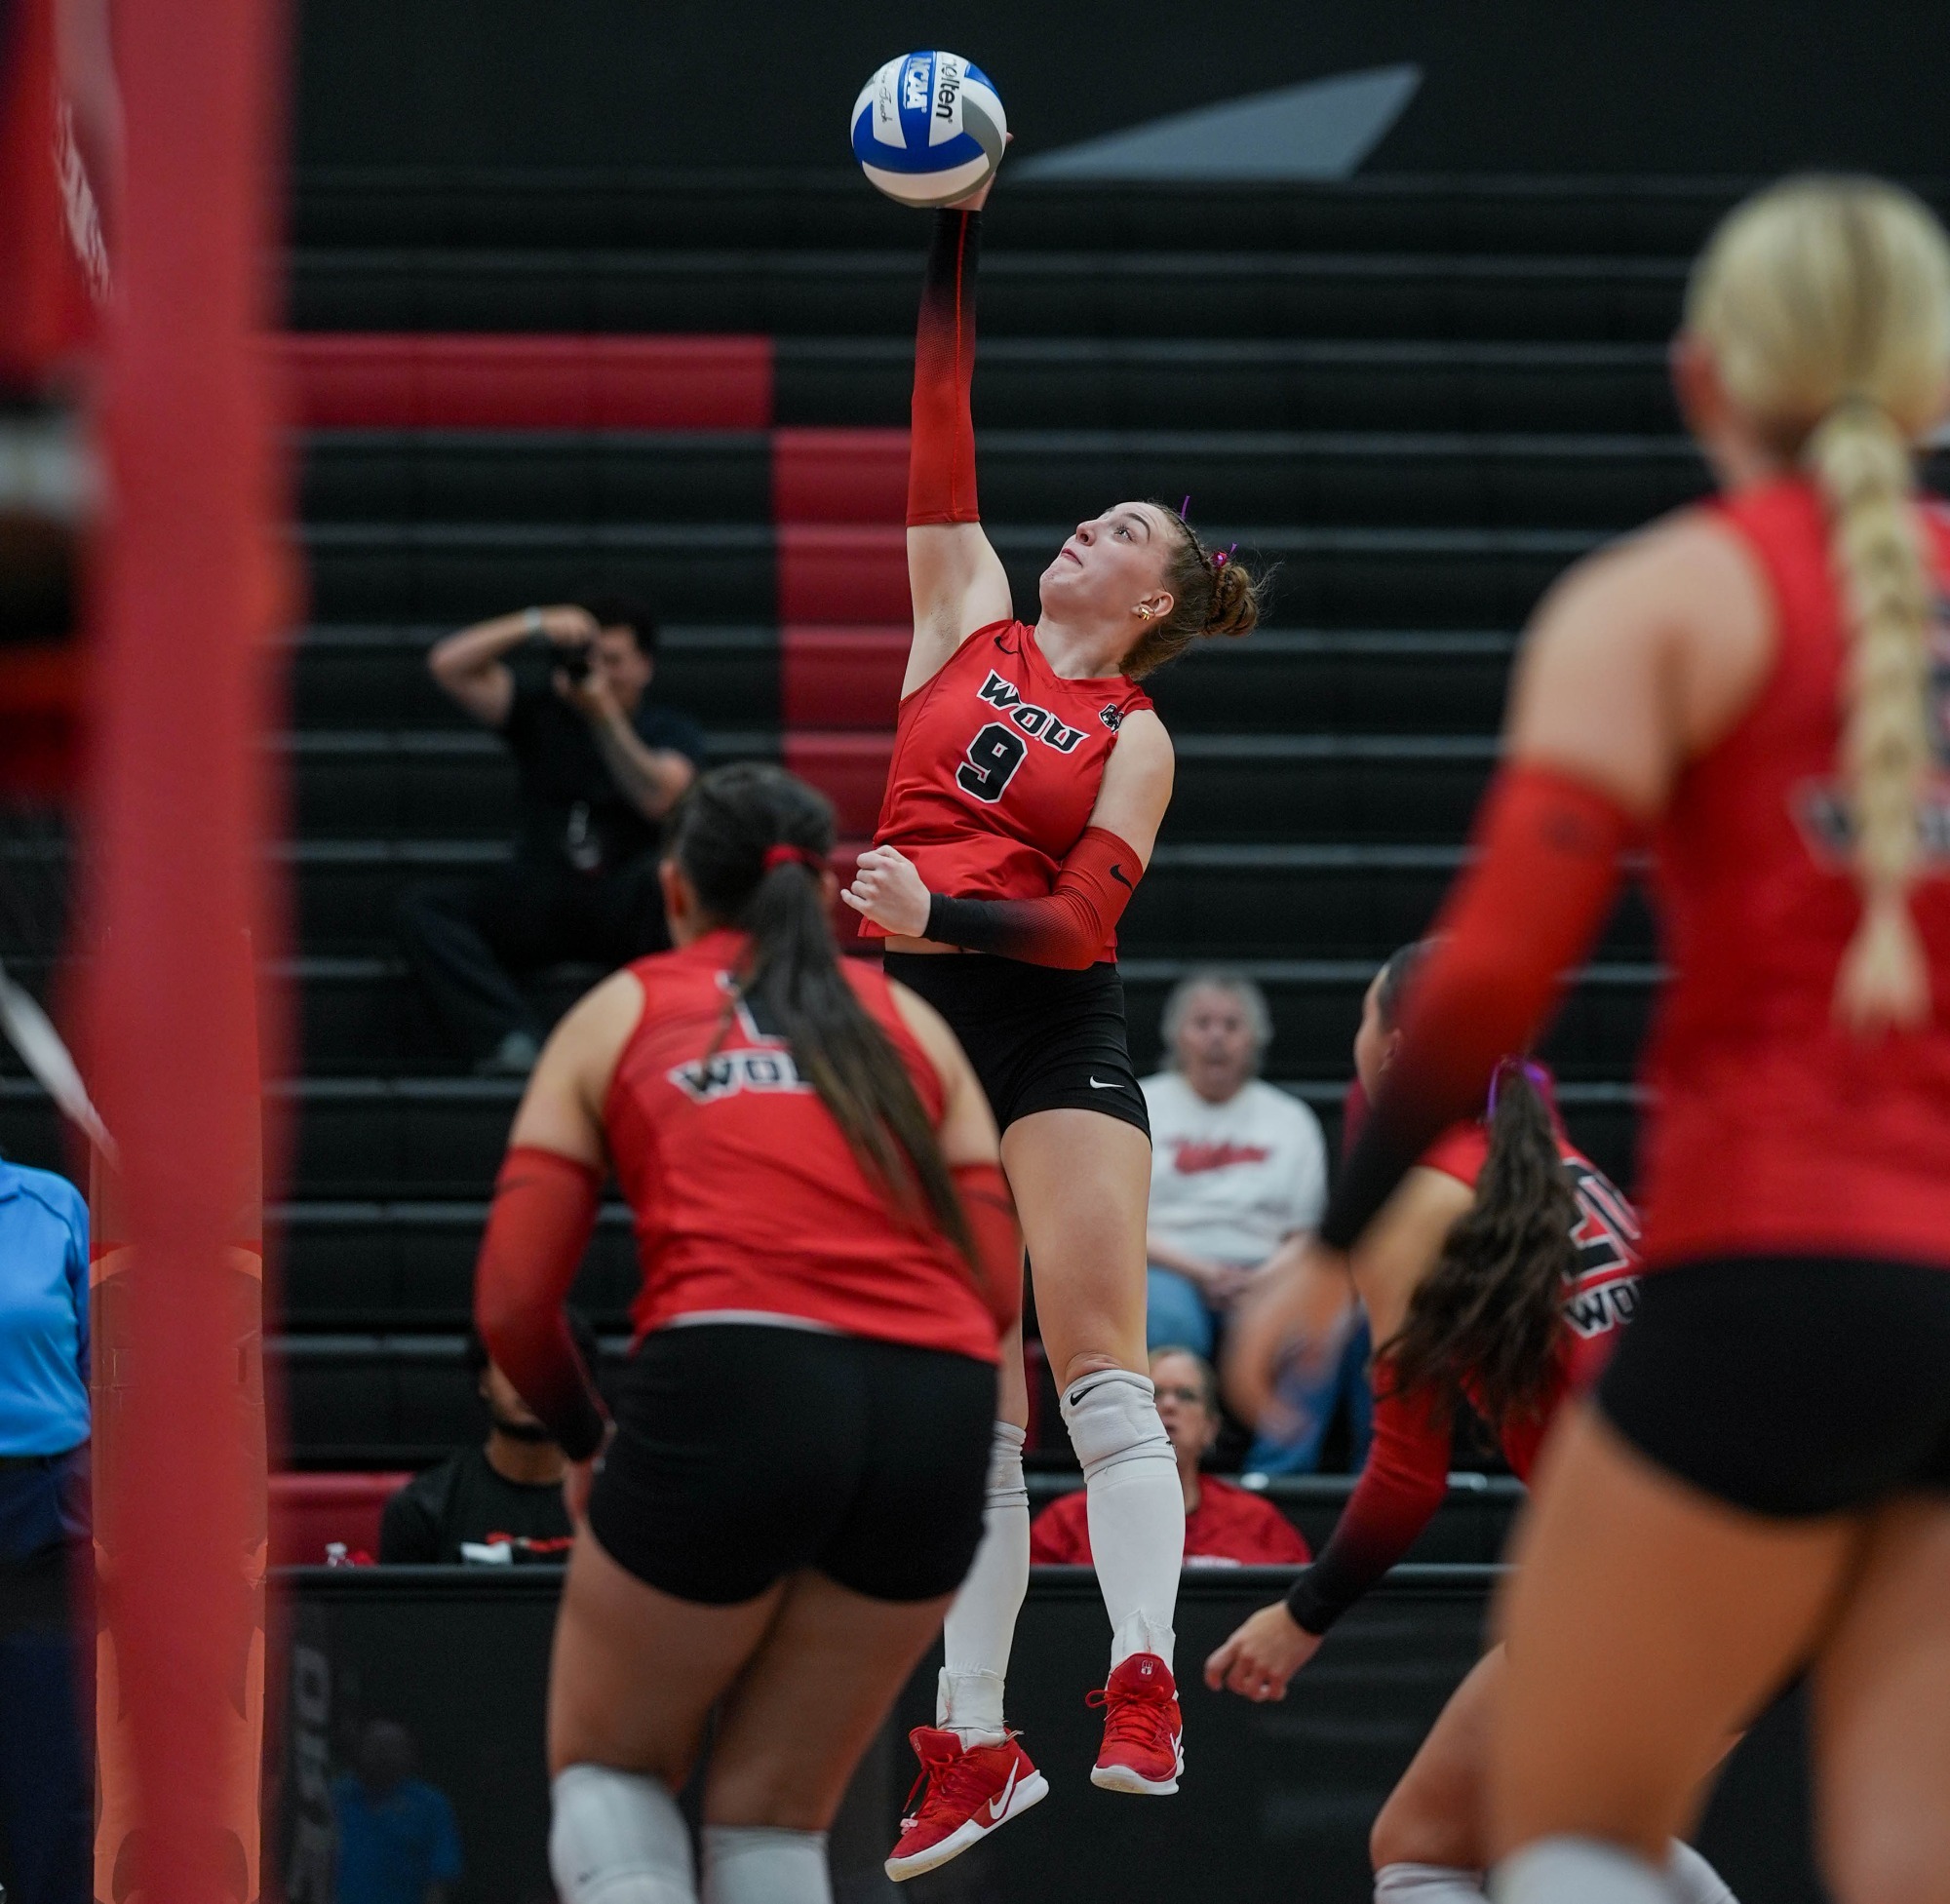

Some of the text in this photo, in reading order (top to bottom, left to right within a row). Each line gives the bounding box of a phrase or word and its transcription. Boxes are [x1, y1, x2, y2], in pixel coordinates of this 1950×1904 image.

[905, 57, 932, 109] NCAA
[976, 668, 1091, 755] WOU
[955, 721, 1029, 804] 9
